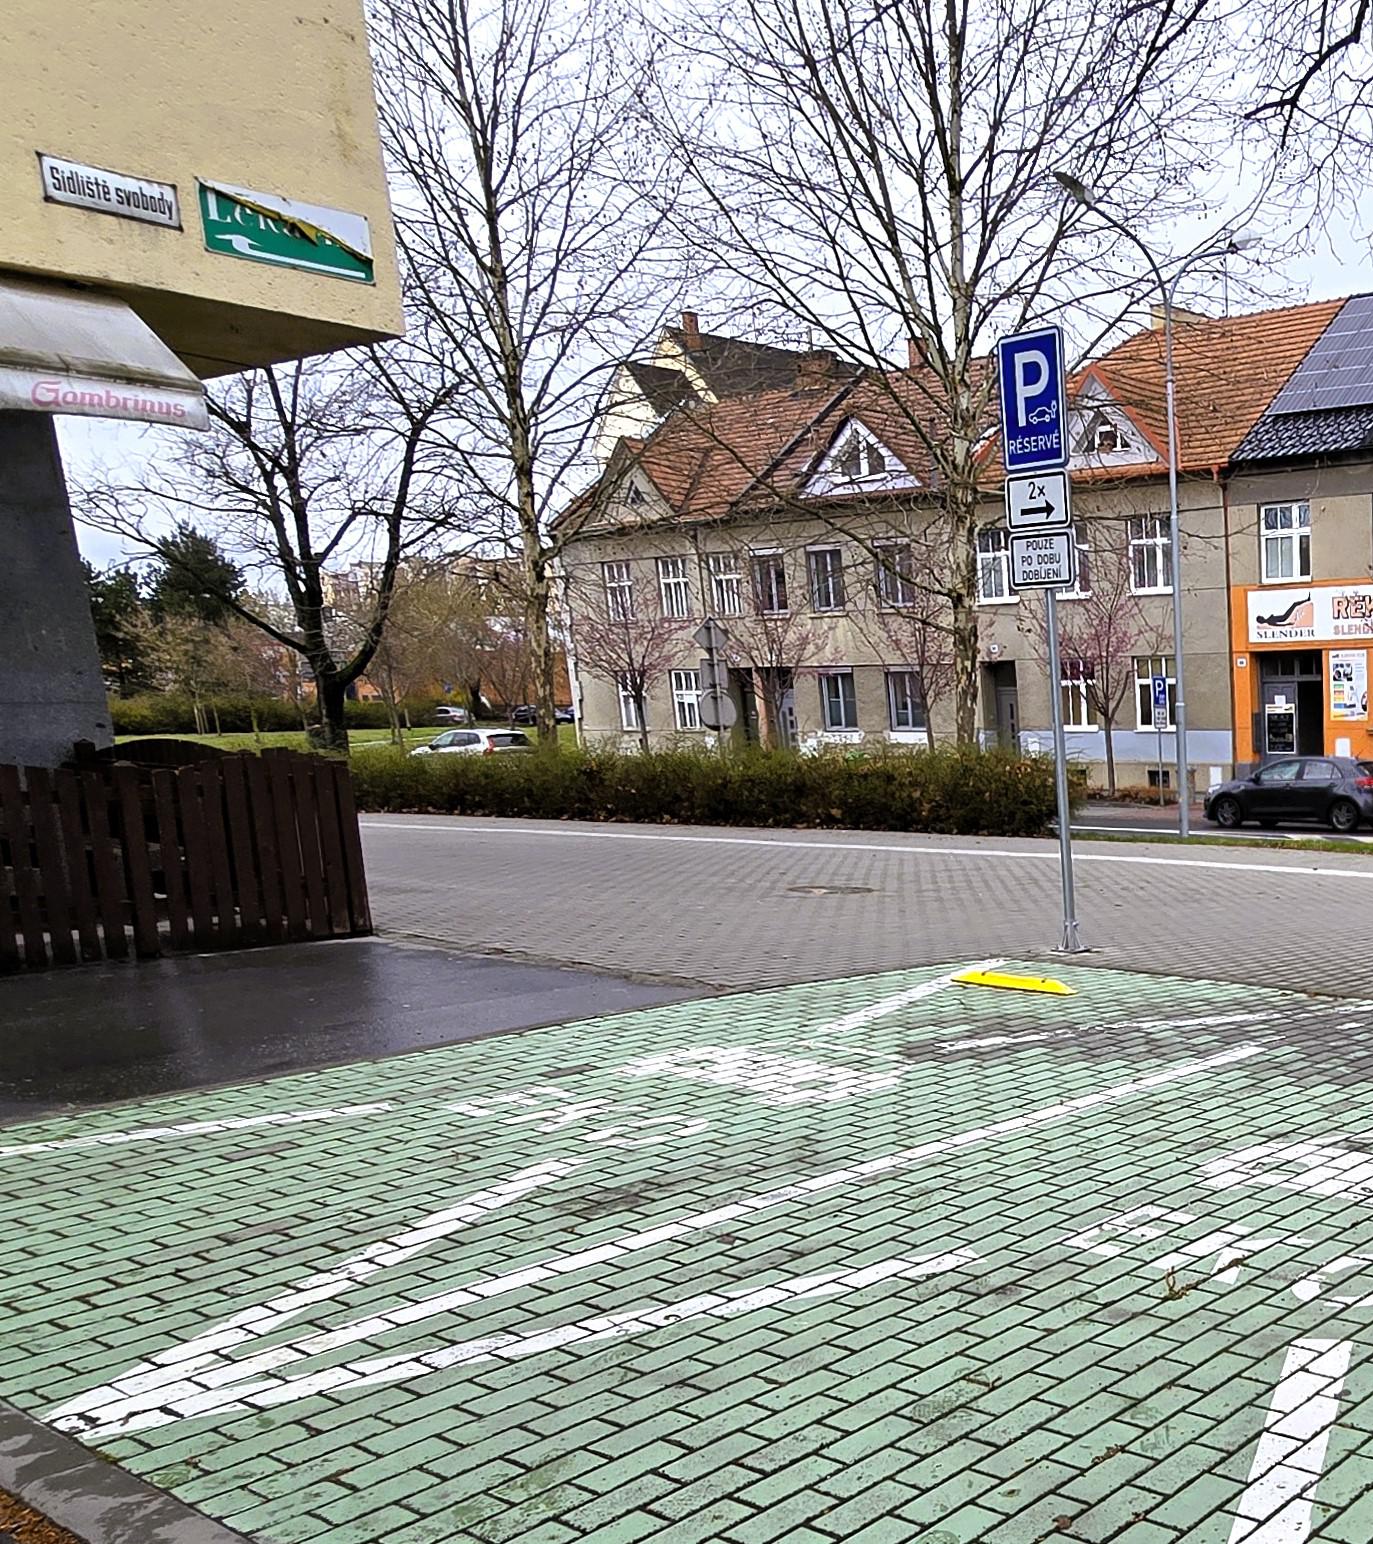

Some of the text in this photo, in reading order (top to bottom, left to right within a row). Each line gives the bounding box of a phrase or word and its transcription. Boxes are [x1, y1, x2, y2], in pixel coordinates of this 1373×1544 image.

[115, 187, 173, 220] svobody
[1014, 349, 1050, 427] P
[31, 380, 187, 418] Gambrinus
[1009, 429, 1060, 455] RÉSERVÉ
[1028, 481, 1046, 500] 2x
[1026, 538, 1055, 551] POUZE
[1021, 552, 1061, 566] PO DOBU
[1022, 563, 1062, 581] DOBÍJENÍ
[1256, 629, 1315, 639] SLENDER
[1155, 680, 1164, 697] P
